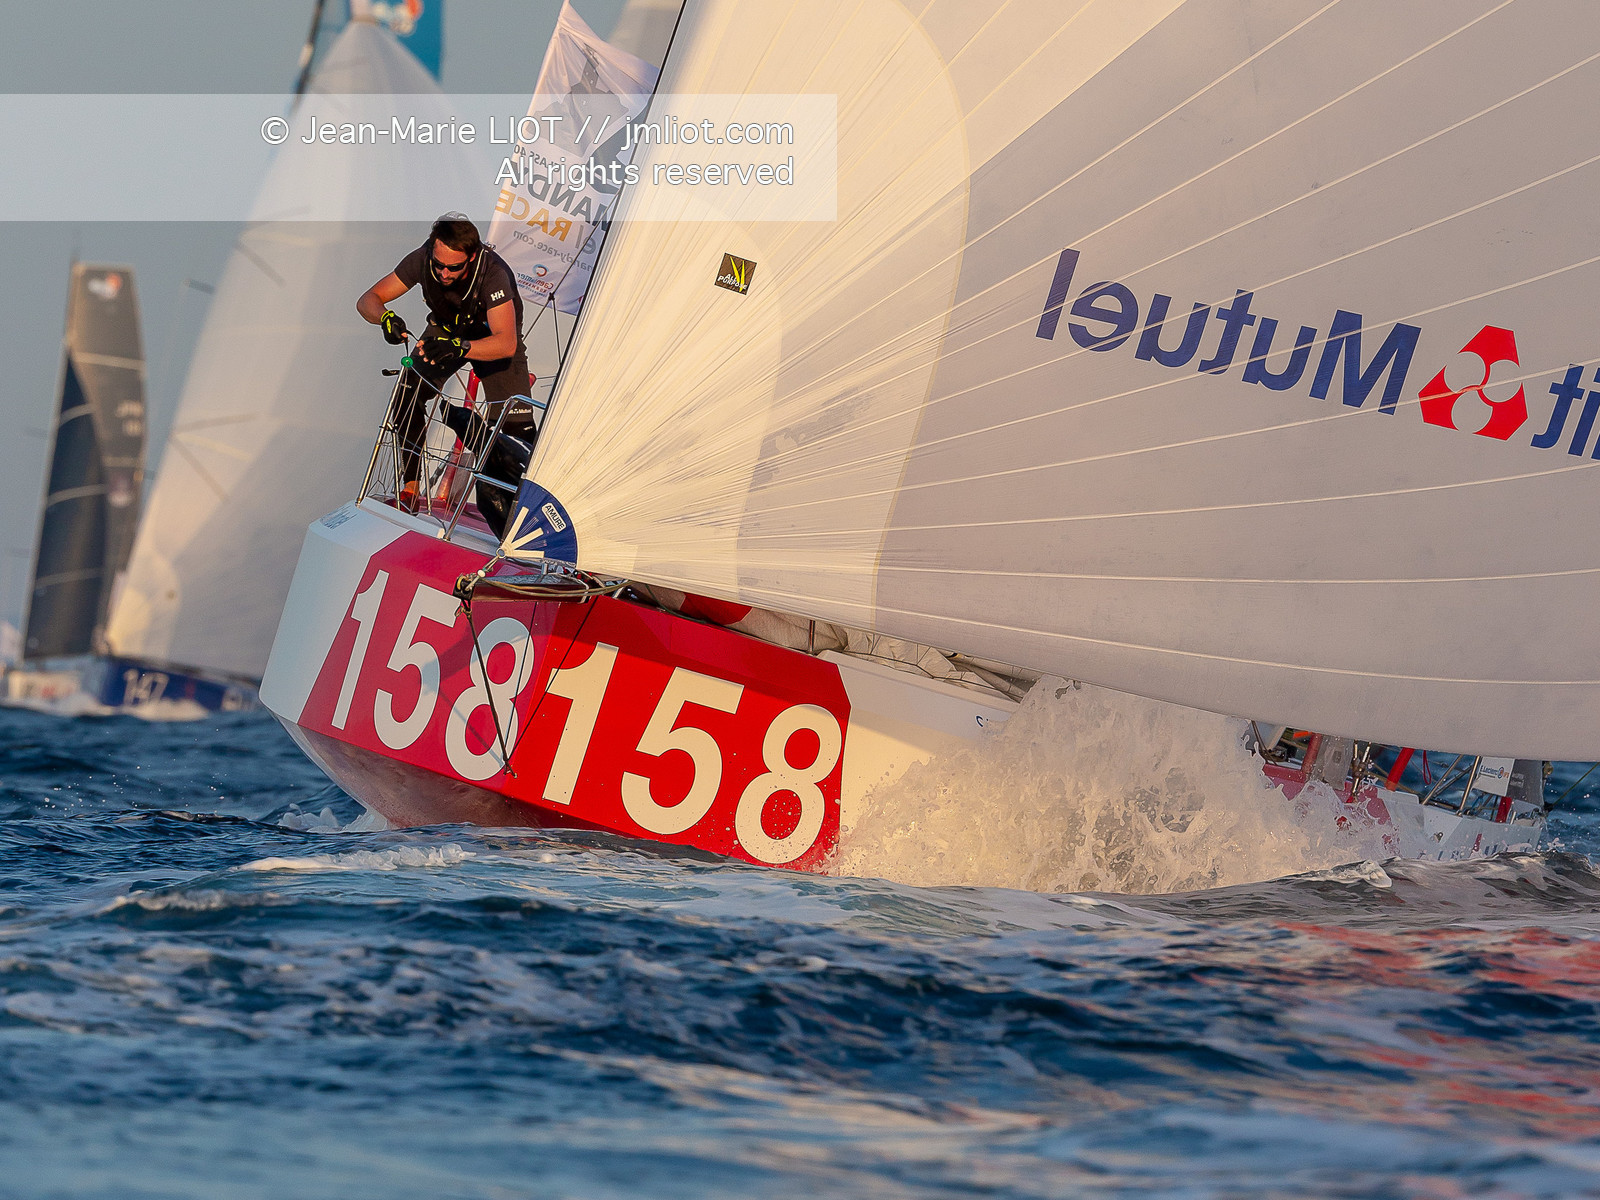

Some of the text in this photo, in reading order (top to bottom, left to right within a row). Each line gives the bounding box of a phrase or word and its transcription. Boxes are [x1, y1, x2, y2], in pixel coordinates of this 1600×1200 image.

[490, 289, 505, 302] HH
[544, 504, 566, 530] AMURE
[331, 569, 534, 781] 158
[542, 641, 843, 865] 158
